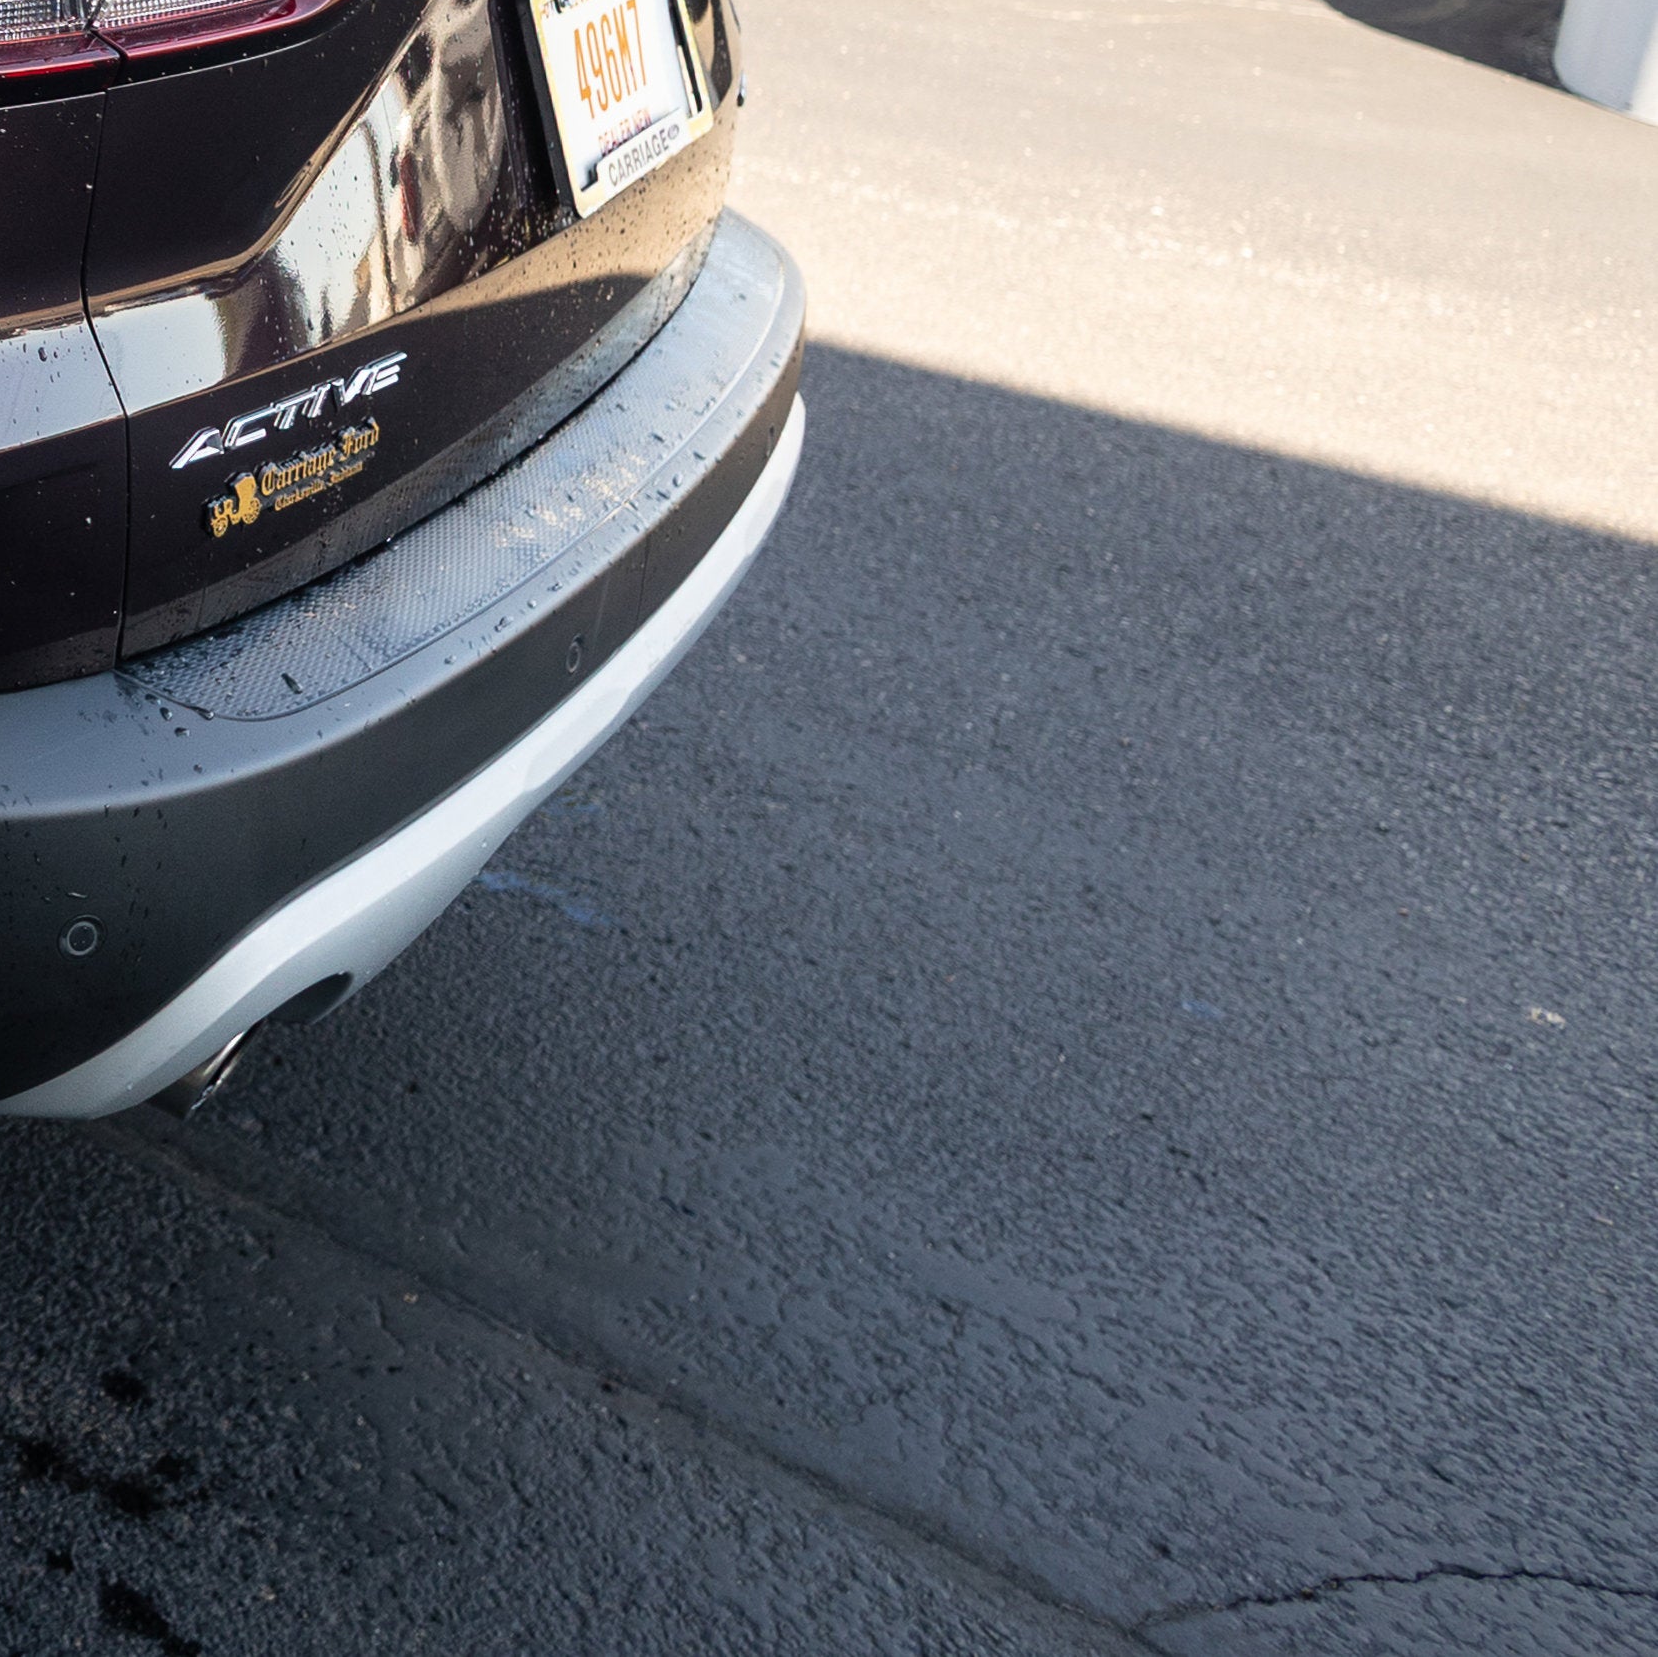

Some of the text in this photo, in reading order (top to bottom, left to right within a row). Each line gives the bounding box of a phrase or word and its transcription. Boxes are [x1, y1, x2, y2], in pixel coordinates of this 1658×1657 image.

[608, 128, 669, 187] CARRIAGE
[168, 350, 408, 470] ACTIVE
[261, 417, 380, 497] Carriage Ford
